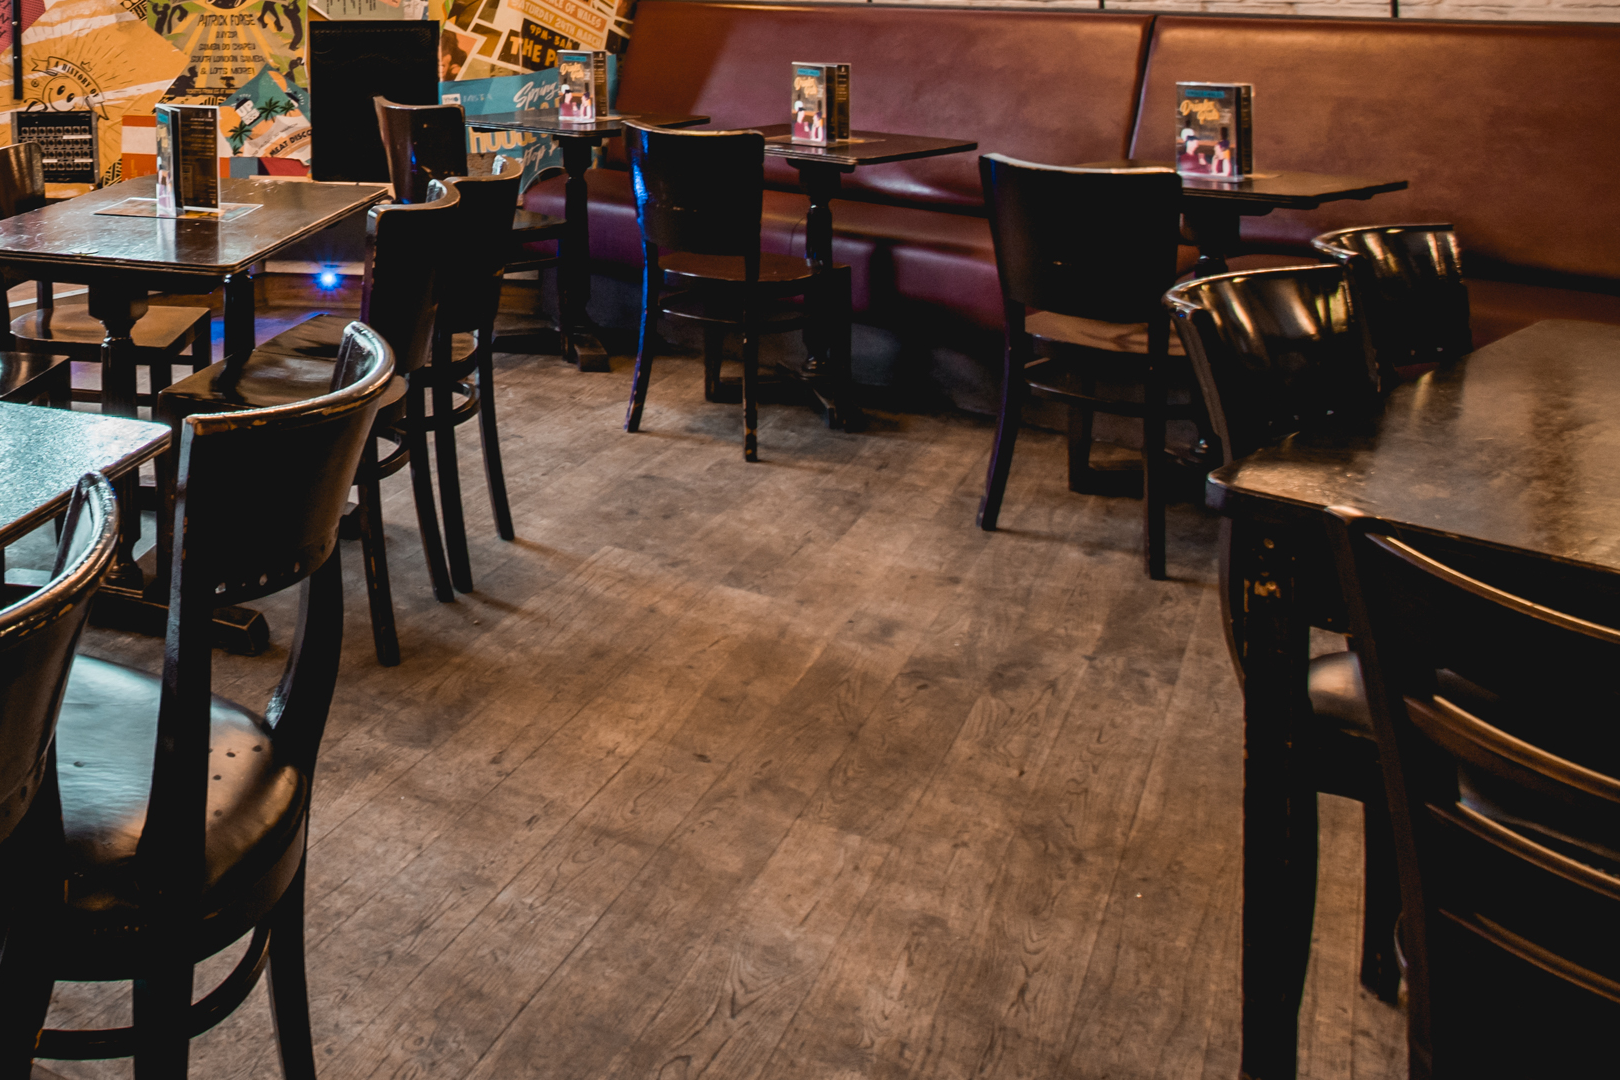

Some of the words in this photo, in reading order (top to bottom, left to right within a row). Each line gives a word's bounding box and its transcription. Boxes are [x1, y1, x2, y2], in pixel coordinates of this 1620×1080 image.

[197, 14, 228, 27] PATRICK
[230, 14, 256, 27] FORGE
[564, 1, 574, 15] OF
[575, 5, 602, 29] WALES
[554, 17, 576, 35] 24TH
[575, 24, 602, 49] MARCH
[190, 55, 212, 63] SOUTH
[213, 54, 239, 63] LONDON
[240, 55, 266, 63] SAMBA
[509, 35, 543, 63] THE
[61, 63, 91, 89] HISTORY
[89, 87, 101, 99] OF
[200, 67, 206, 75] &
[209, 67, 228, 75] LOTS
[513, 80, 560, 111] Spring
